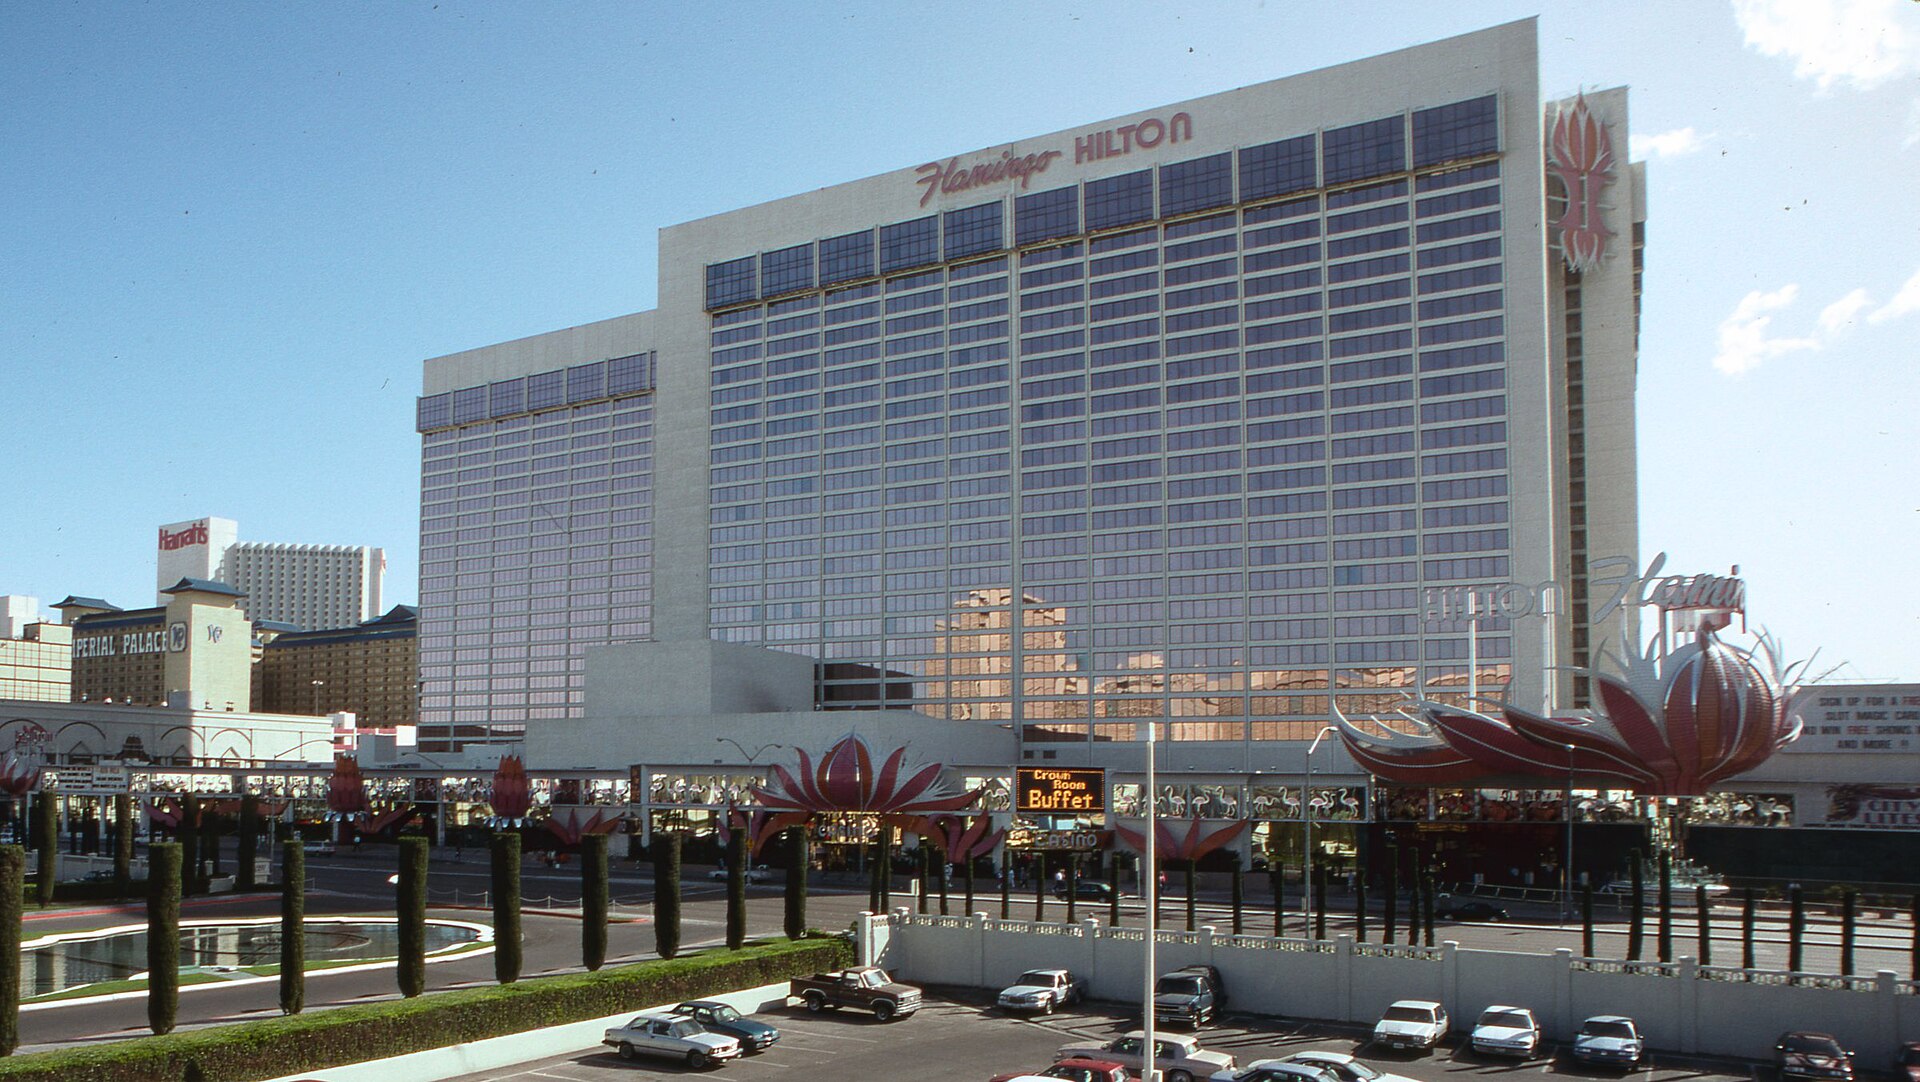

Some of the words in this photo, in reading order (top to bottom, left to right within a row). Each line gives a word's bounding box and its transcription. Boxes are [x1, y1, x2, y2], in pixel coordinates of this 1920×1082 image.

[915, 150, 1062, 208] Flamingo
[1074, 111, 1192, 166] HILTON
[72, 635, 116, 659] PERIAL
[1033, 769, 1071, 780] Crown
[1053, 779, 1086, 790] Room
[1029, 789, 1094, 809] Buffet
